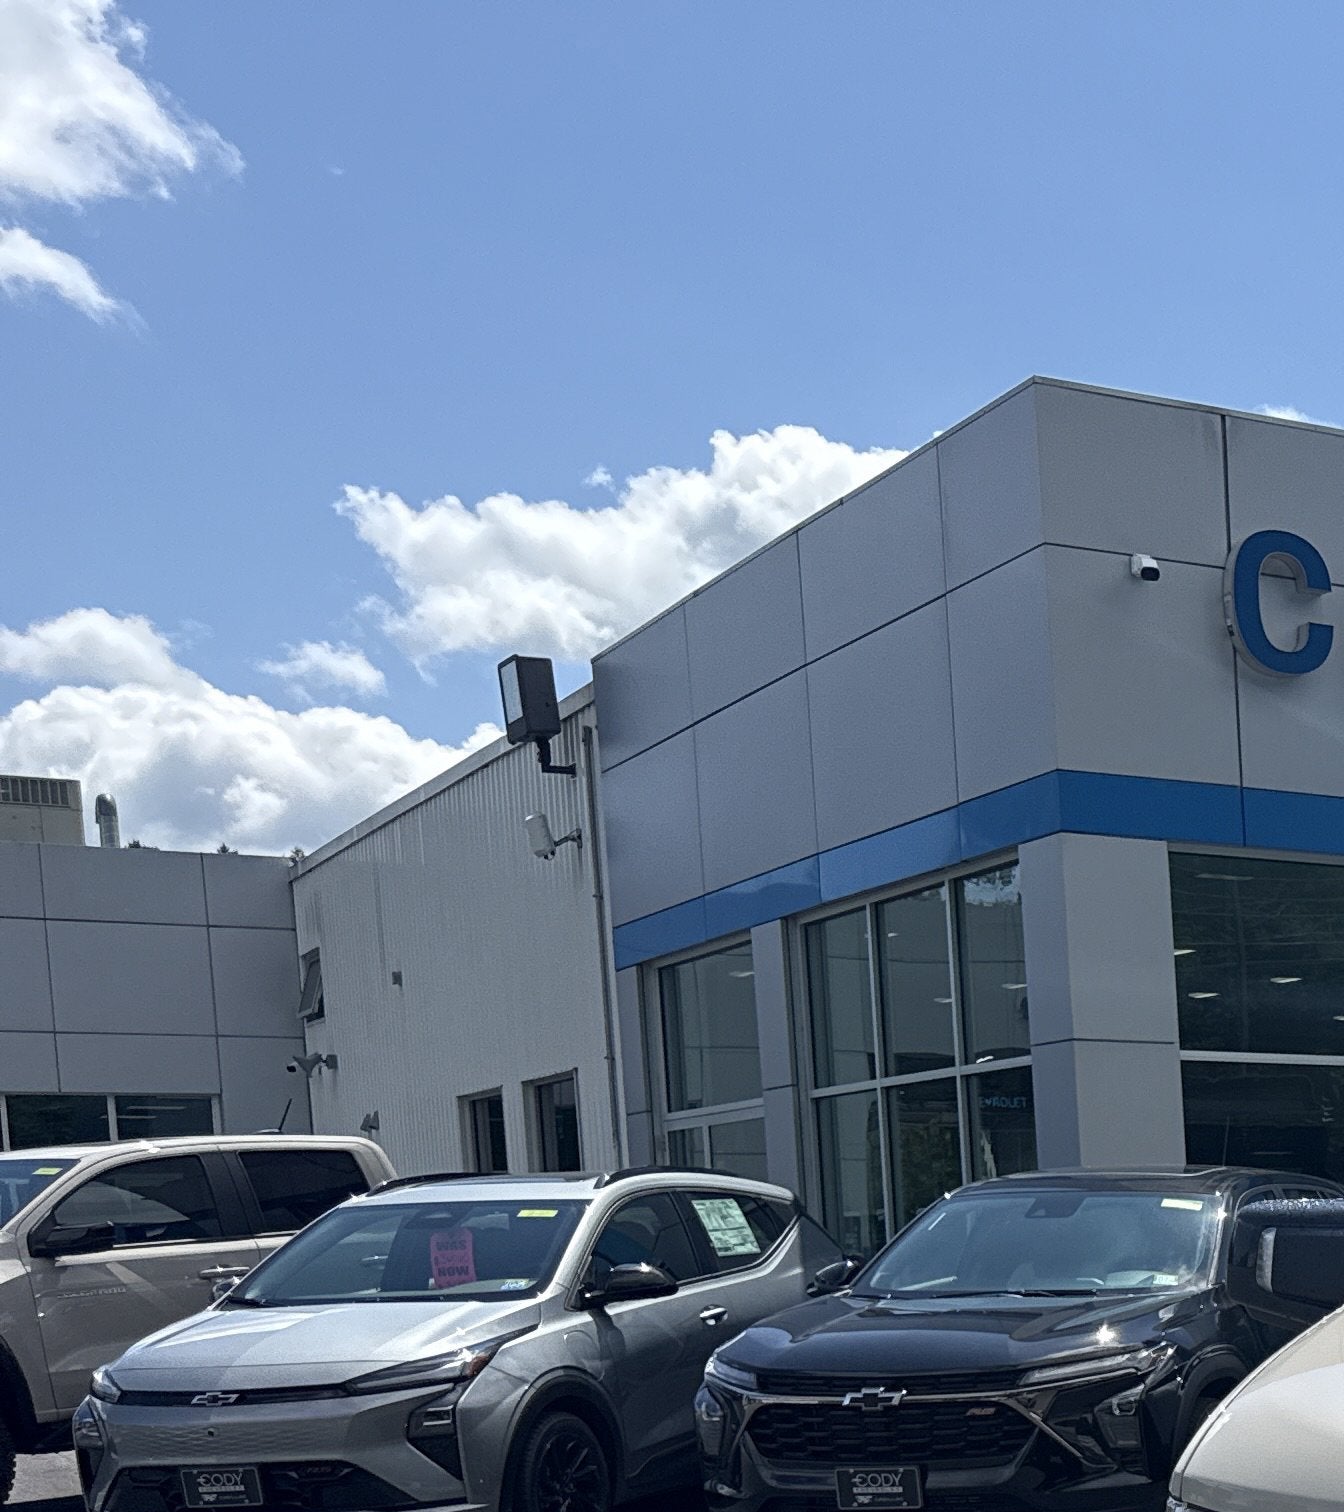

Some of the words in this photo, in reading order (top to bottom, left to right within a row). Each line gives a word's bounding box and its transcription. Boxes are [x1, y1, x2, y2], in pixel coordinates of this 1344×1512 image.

[436, 1239, 467, 1251] WAS
[437, 1265, 469, 1277] NOW
[199, 1472, 243, 1487] CODY
[855, 1473, 902, 1487] CODY
